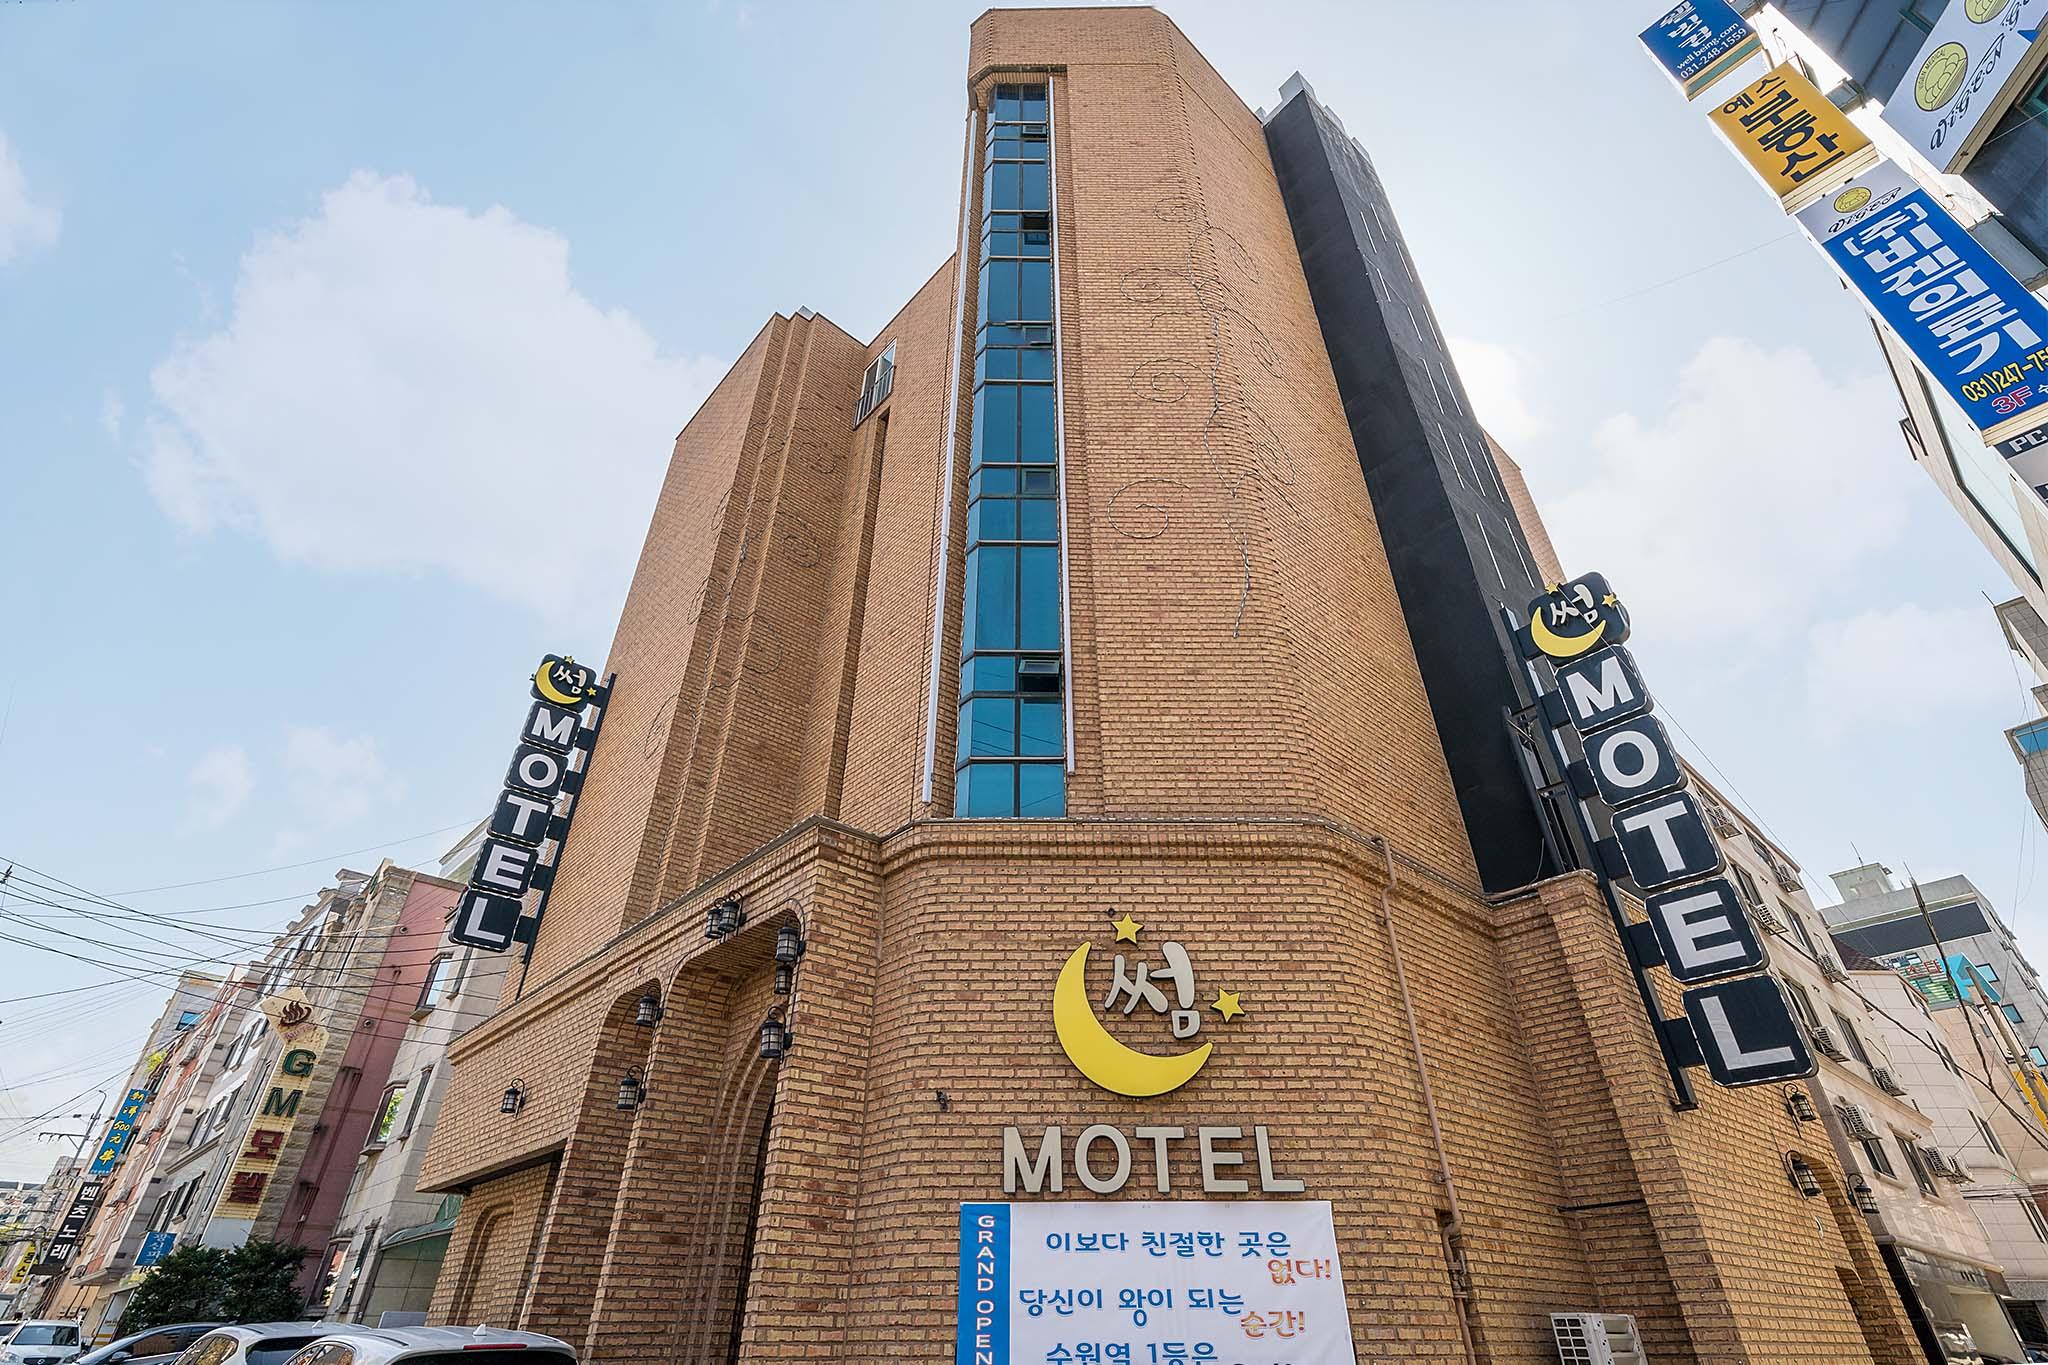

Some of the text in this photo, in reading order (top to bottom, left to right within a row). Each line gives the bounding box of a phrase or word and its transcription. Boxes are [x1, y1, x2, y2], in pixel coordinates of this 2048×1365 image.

[1680, 28, 1747, 78] 031-248-1559
[1722, 76, 1786, 115] 예스
[1738, 88, 1846, 183] 부동산
[1961, 346, 2048, 402] 031)247-75
[1991, 385, 2033, 414] 3F
[2009, 429, 2048, 452] PC
[1550, 584, 1598, 626] 썸
[553, 665, 587, 694] 썸
[463, 707, 575, 943] MOTEL
[1566, 661, 1796, 1072] MOTEL
[1104, 941, 1200, 1039] 썸
[262, 1048, 317, 1118] GM
[228, 1129, 285, 1204] 모텔
[1002, 1124, 1306, 1195] MOTEL
[1045, 1230, 1292, 1257] 이보다 친절한 곳은
[975, 1215, 996, 1365] GRAND OPEN
[1267, 1258, 1332, 1286] 없다!
[1019, 1288, 1245, 1328] 당신이 왕이 되는
[1240, 1310, 1306, 1339] 순간!
